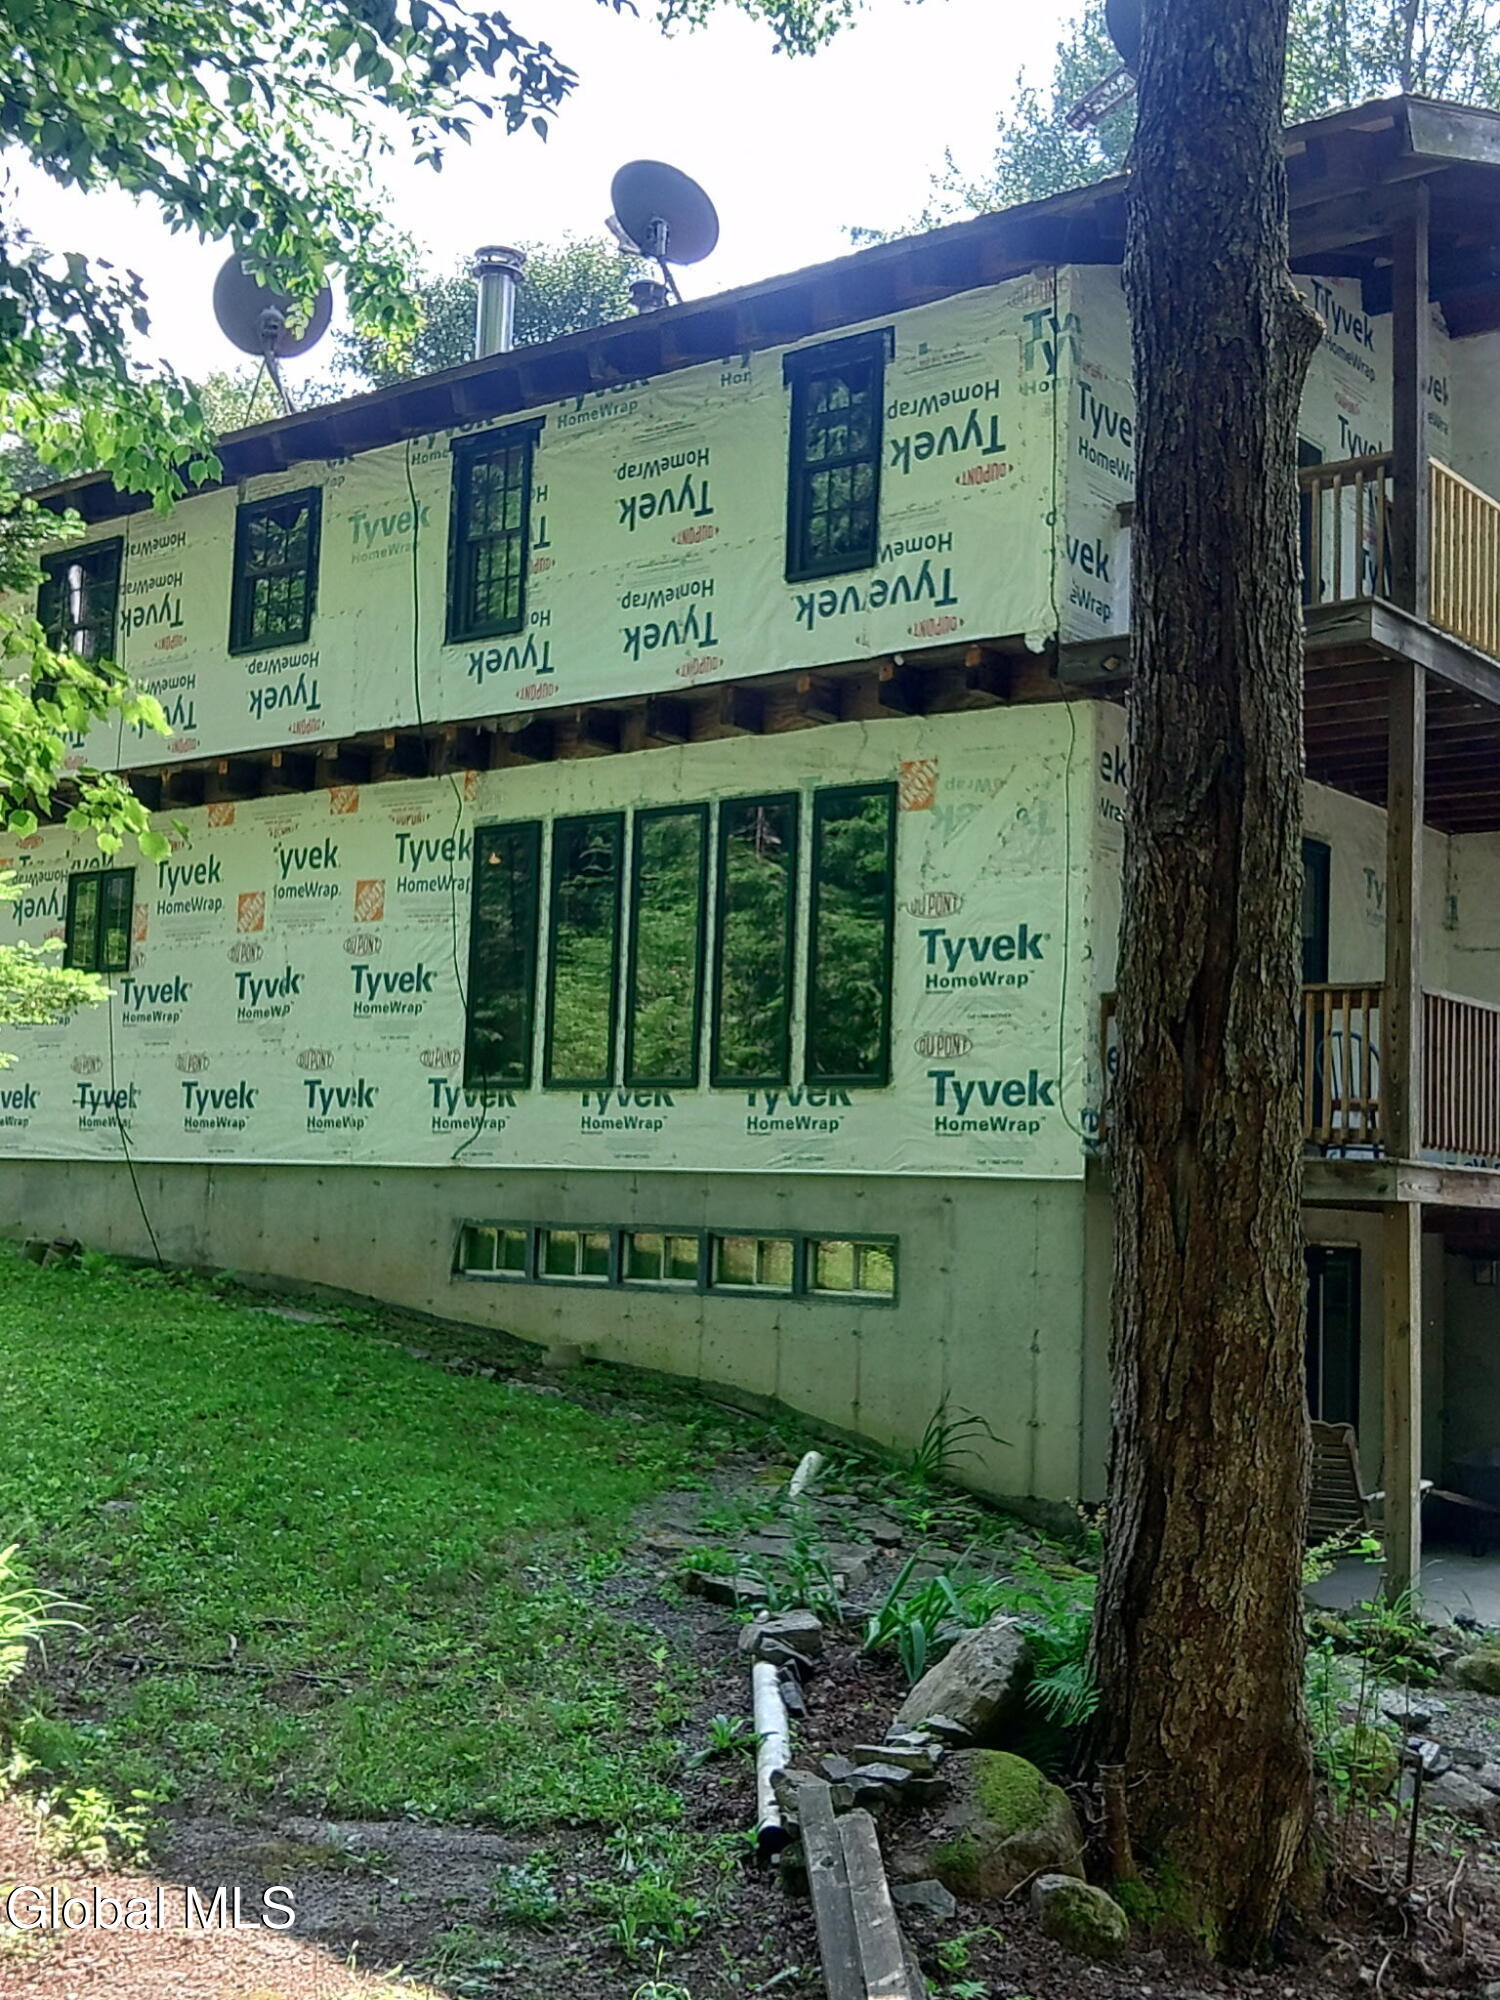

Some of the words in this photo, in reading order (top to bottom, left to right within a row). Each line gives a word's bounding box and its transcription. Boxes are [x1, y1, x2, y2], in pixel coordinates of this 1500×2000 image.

[558, 400, 638, 429] HomeWrap
[887, 379, 1000, 419] HomeWrap
[1077, 381, 1134, 448] Tyve
[890, 408, 1007, 475] Tyvek
[617, 448, 710, 480] HomeWrap
[1078, 437, 1135, 485] HomeWr
[619, 474, 714, 532] Tyvek
[349, 501, 430, 548] Tyvek
[1066, 533, 1110, 583] vek
[620, 579, 714, 609] HomeWrap
[121, 592, 184, 637] Tyvek
[623, 604, 719, 661] Tyvek
[248, 652, 319, 674] HomeWrap
[468, 634, 555, 684] Tyvek
[249, 673, 321, 719] Tyvek
[277, 838, 339, 879] yvek
[395, 829, 472, 872] Tyvek
[157, 897, 223, 915] HomeWrap
[919, 924, 1044, 972] Tyvek
[120, 976, 188, 1008] Tyvek
[351, 963, 433, 1000] Tyvek
[925, 972, 1029, 990] HomeWrap
[123, 1010, 180, 1024] HomeWrap
[354, 1001, 423, 1015] HomeWrap
[0, 1083, 37, 1109] vek
[77, 1082, 137, 1115] Tyvek
[182, 1081, 256, 1115] Tyvek
[927, 1069, 1055, 1115] Tyvek
[184, 1117, 246, 1130] HomeWrap
[432, 1116, 506, 1131] HomeWrap
[581, 1116, 663, 1132] HomeWrap
[747, 1116, 840, 1133] HomeWrap
[935, 1116, 1041, 1135] HomeWrap
